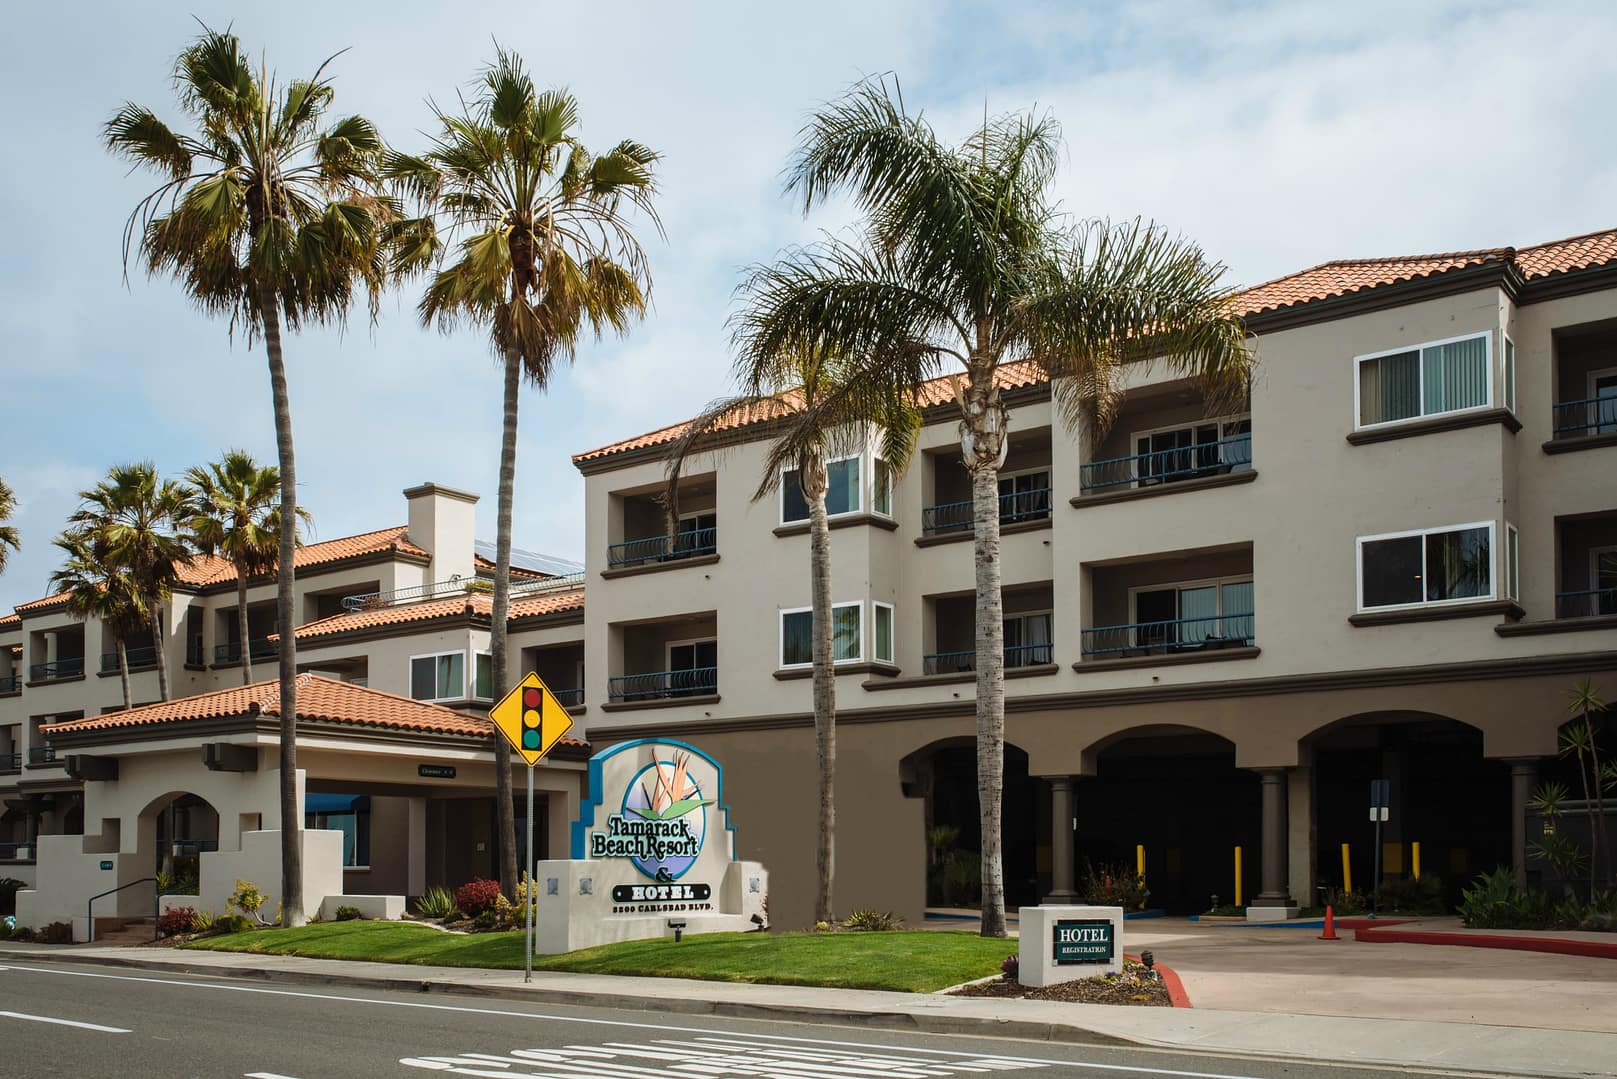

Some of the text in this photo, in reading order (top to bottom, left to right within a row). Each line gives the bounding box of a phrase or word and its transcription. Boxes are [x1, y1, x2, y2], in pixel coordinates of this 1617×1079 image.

[610, 817, 691, 840] Tamarack
[593, 834, 698, 860] Beach Resort
[656, 867, 675, 881] &
[632, 886, 694, 900] HOTEL
[638, 904, 687, 913] CARLSBAD
[1060, 929, 1108, 942] HOTEL
[1062, 946, 1106, 954] REGISTRATION
